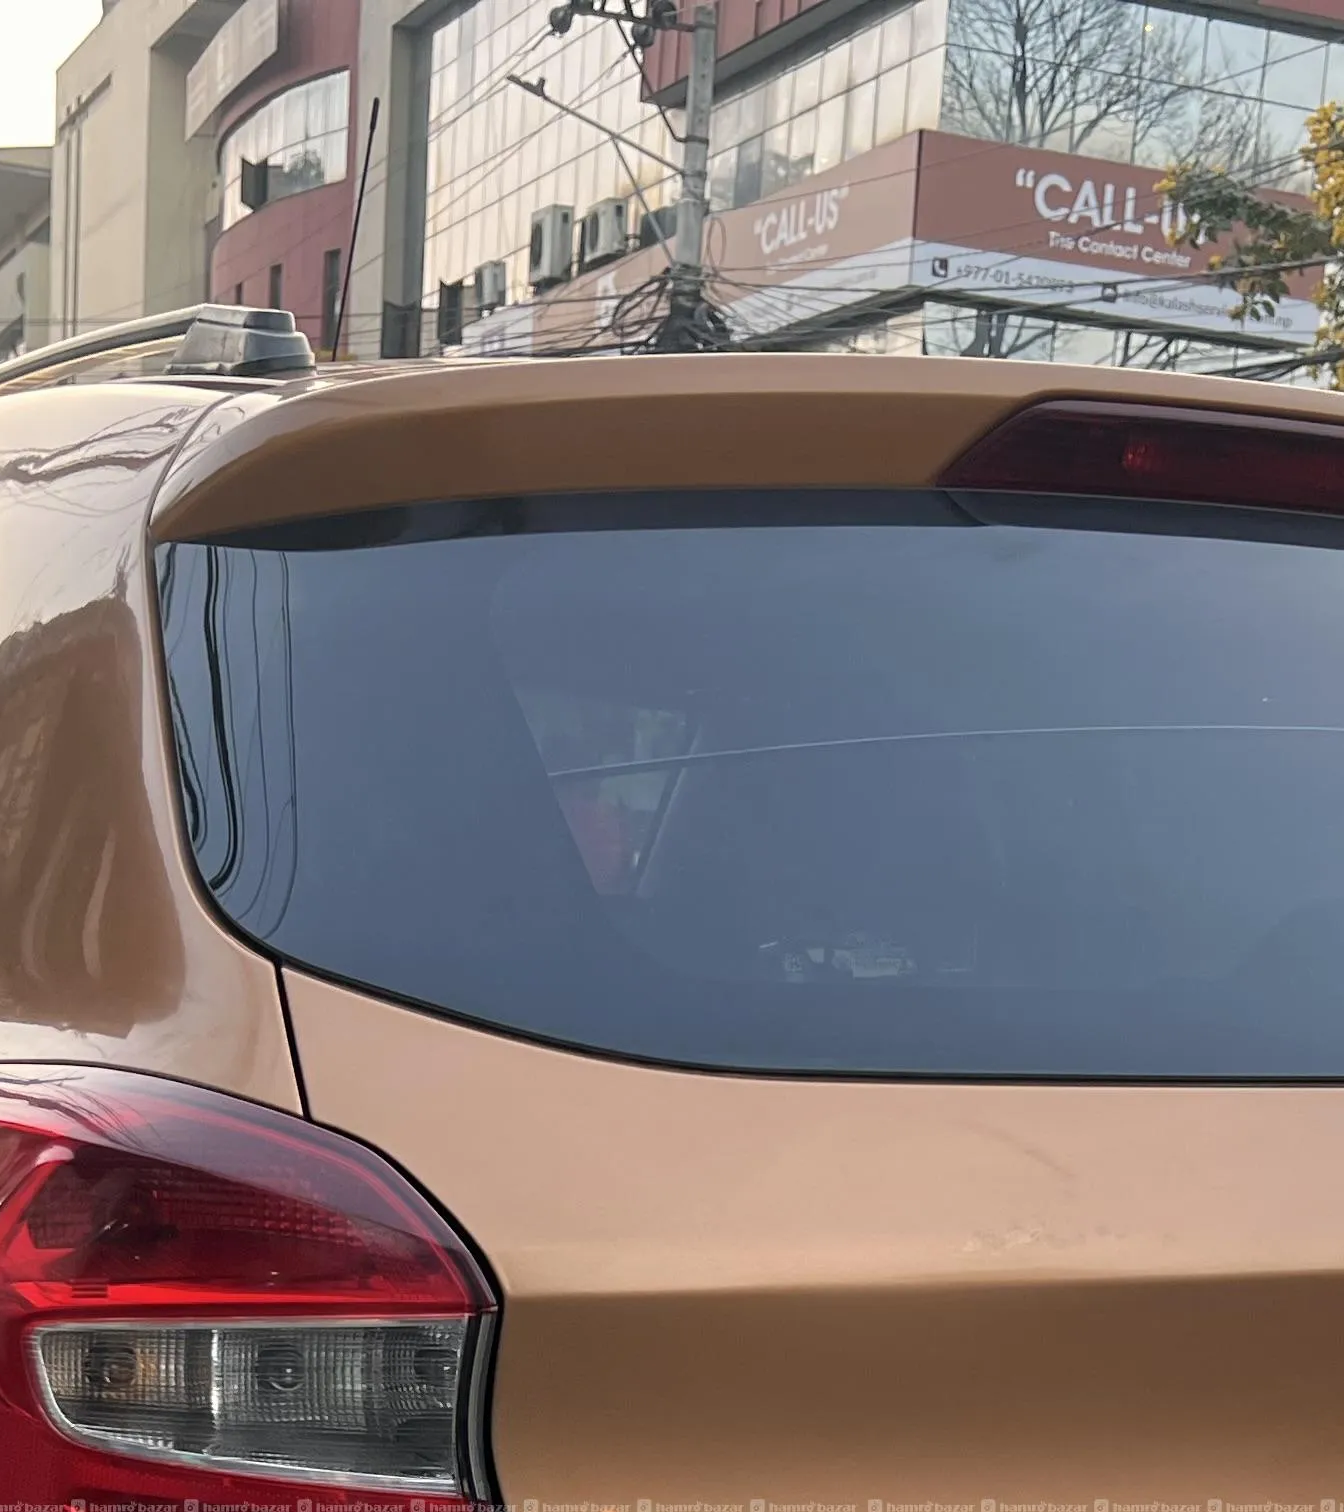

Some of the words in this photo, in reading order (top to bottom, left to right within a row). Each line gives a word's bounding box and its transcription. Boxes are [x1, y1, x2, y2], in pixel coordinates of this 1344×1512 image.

[1048, 231, 1076, 251] The
[1077, 236, 1139, 261] Contact
[1140, 246, 1192, 269] Center
